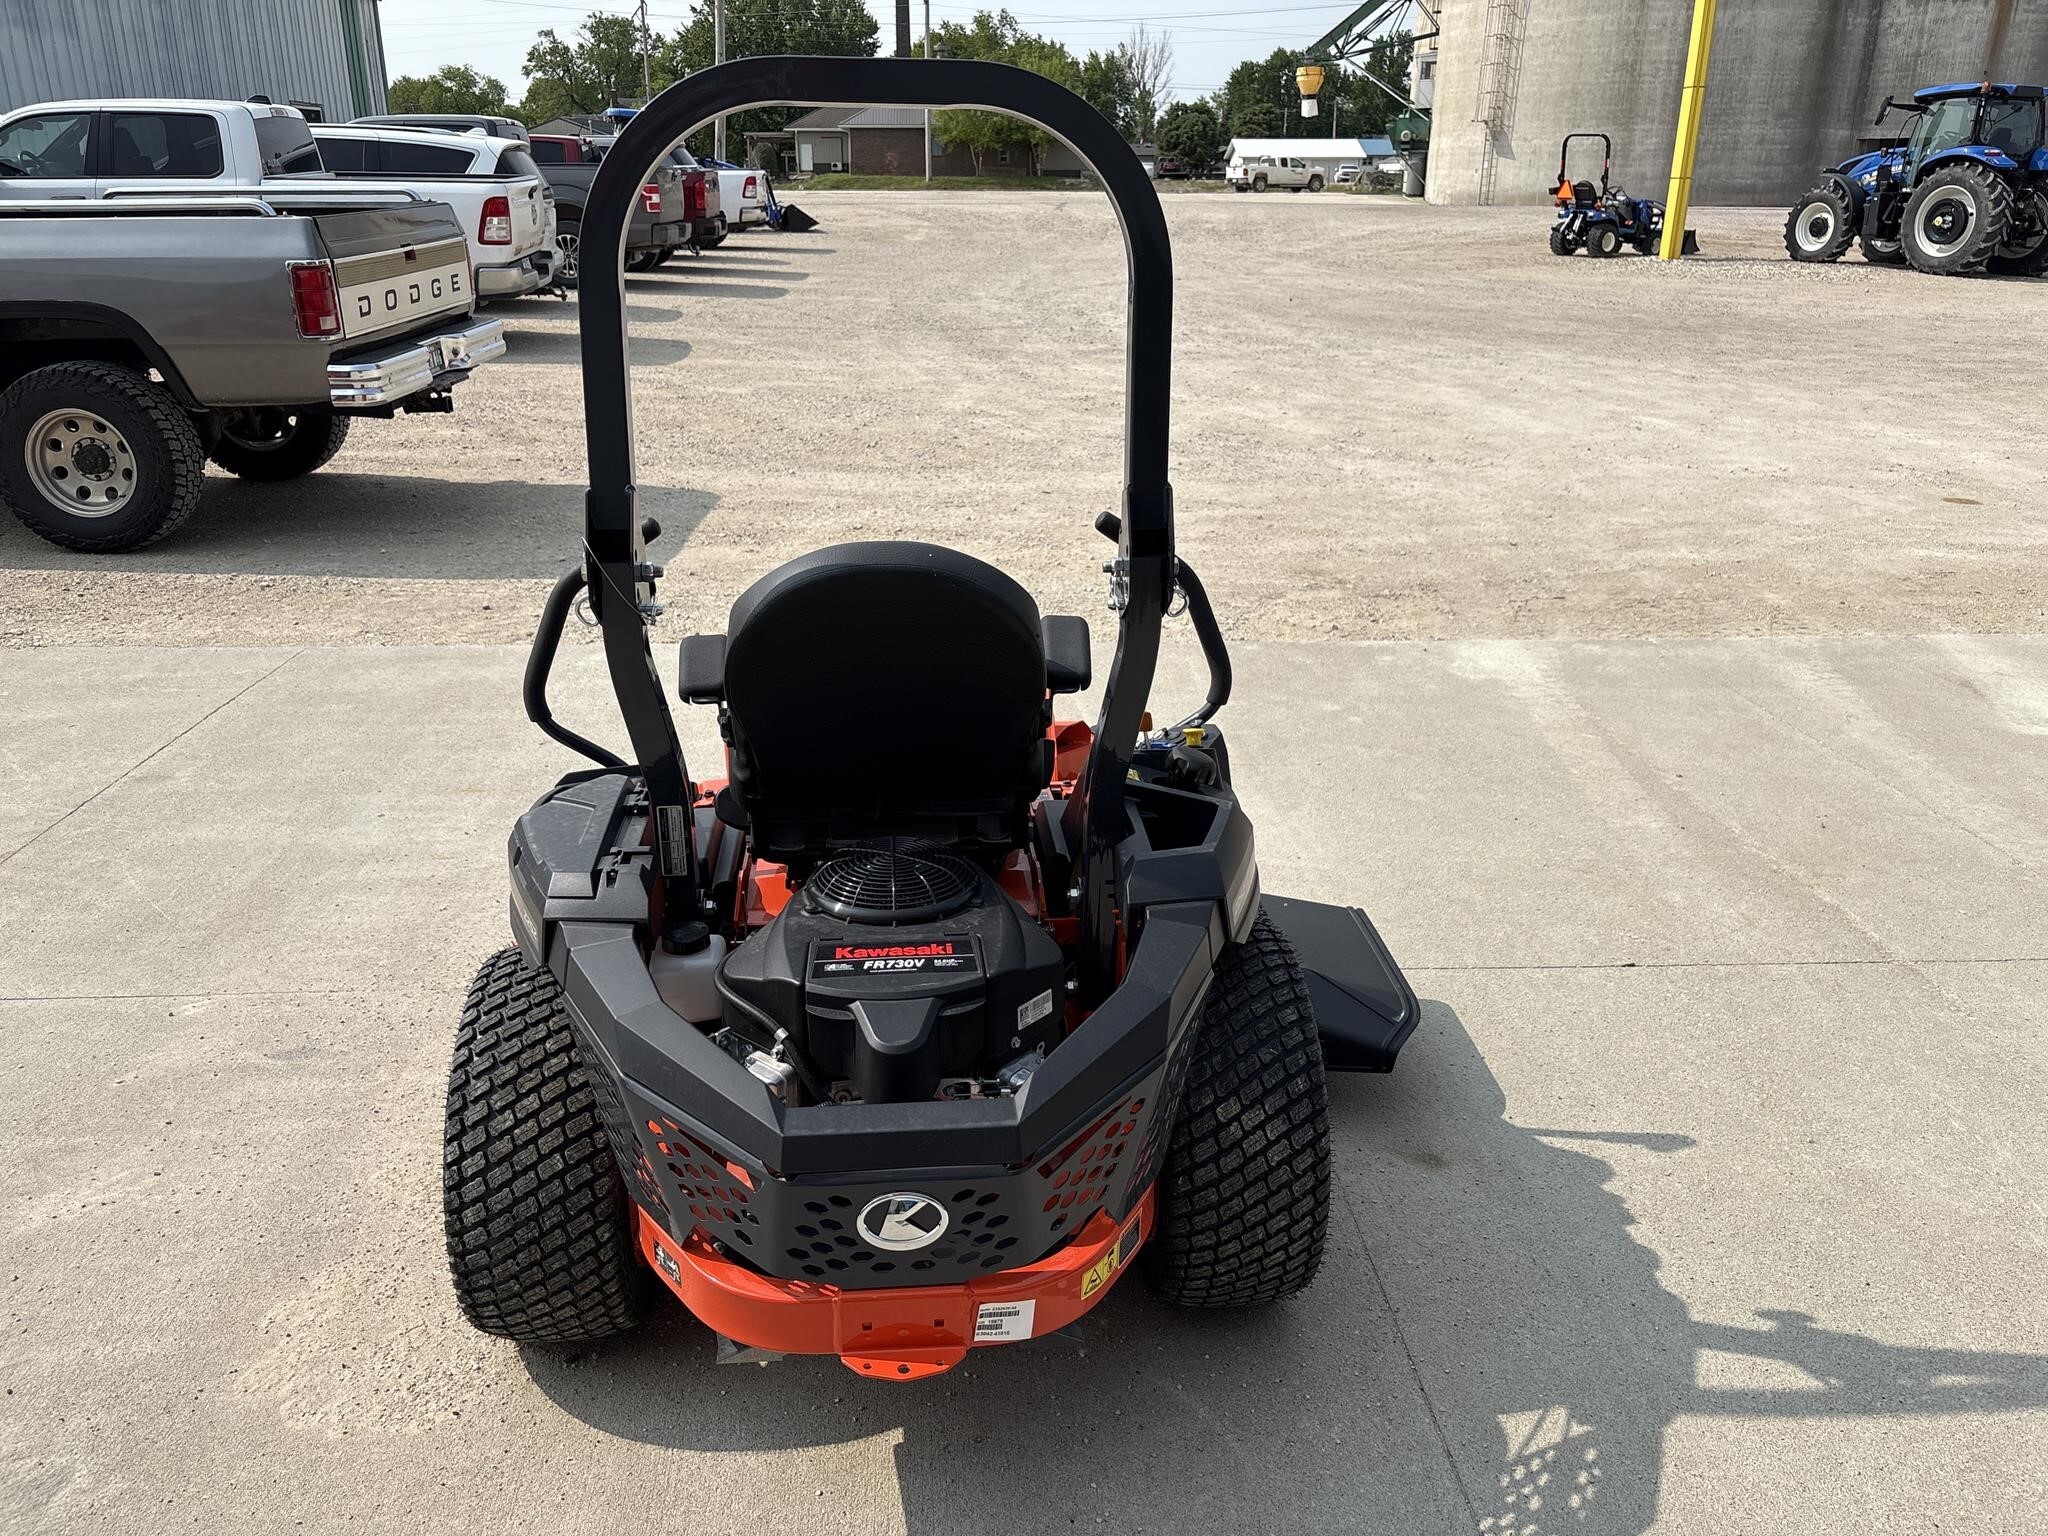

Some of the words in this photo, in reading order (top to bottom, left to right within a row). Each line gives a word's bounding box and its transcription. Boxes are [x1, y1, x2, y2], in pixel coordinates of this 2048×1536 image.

[358, 273, 461, 318] DODGE
[835, 943, 953, 959] Kawasaki
[863, 958, 925, 970] FR730V
